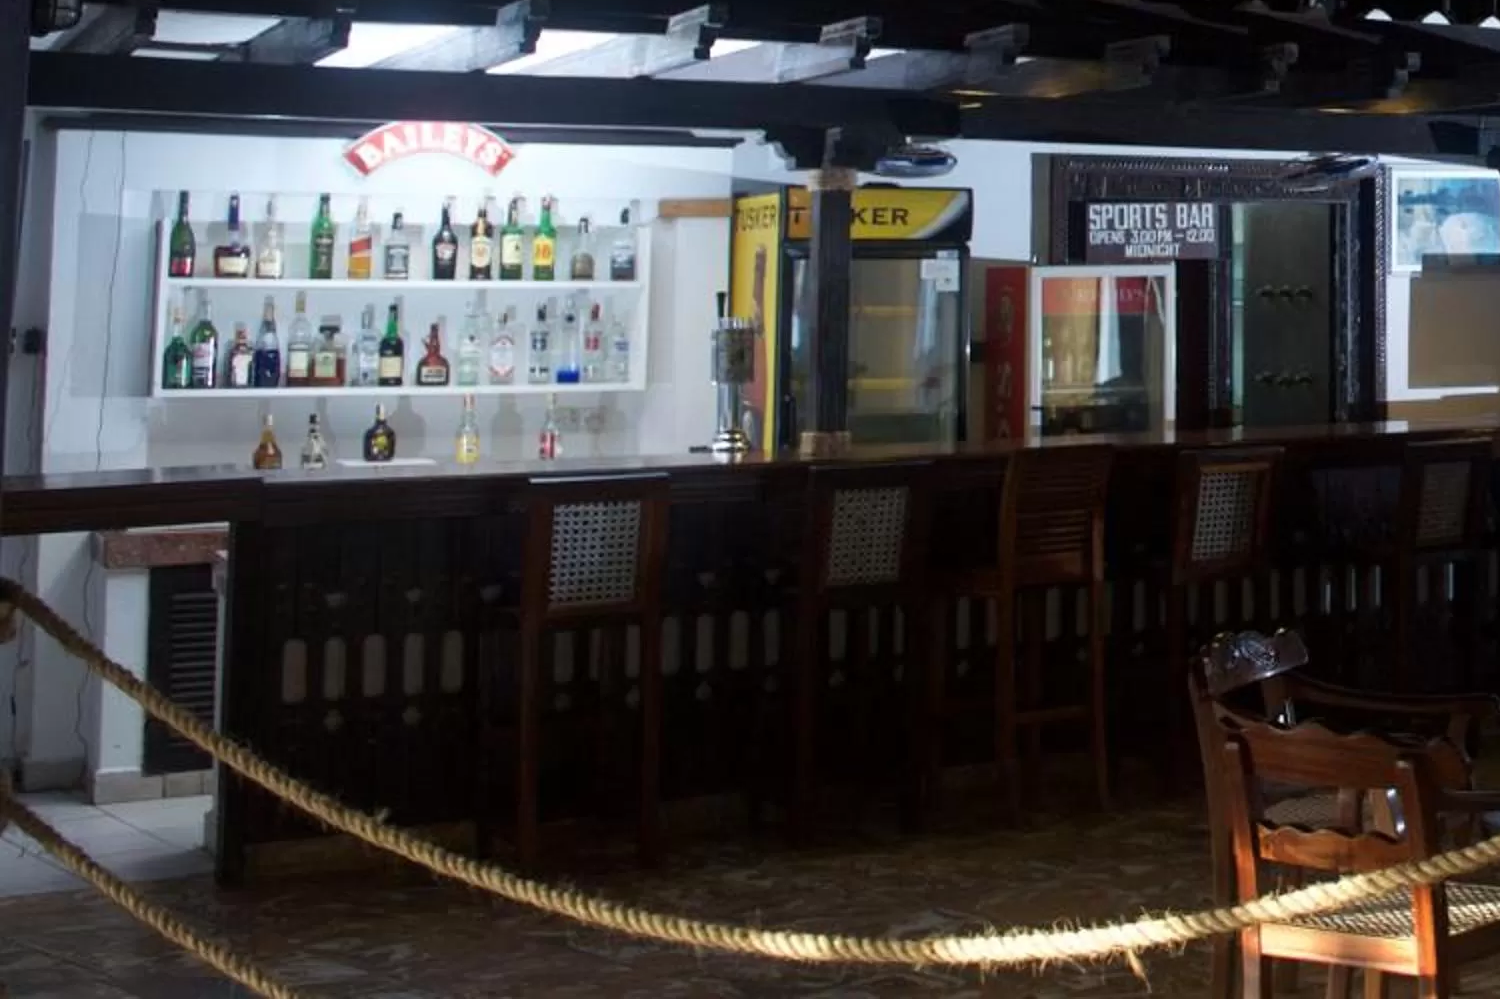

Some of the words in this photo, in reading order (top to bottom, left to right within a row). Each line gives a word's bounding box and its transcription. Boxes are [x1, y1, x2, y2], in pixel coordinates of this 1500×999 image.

[355, 121, 504, 168] BAILEYS
[789, 207, 910, 226] TKER
[1089, 203, 1168, 230] SPORTS
[1175, 203, 1214, 229] BAR
[1089, 230, 1125, 245] OPENS
[1124, 243, 1180, 258] MIDNIGHT
